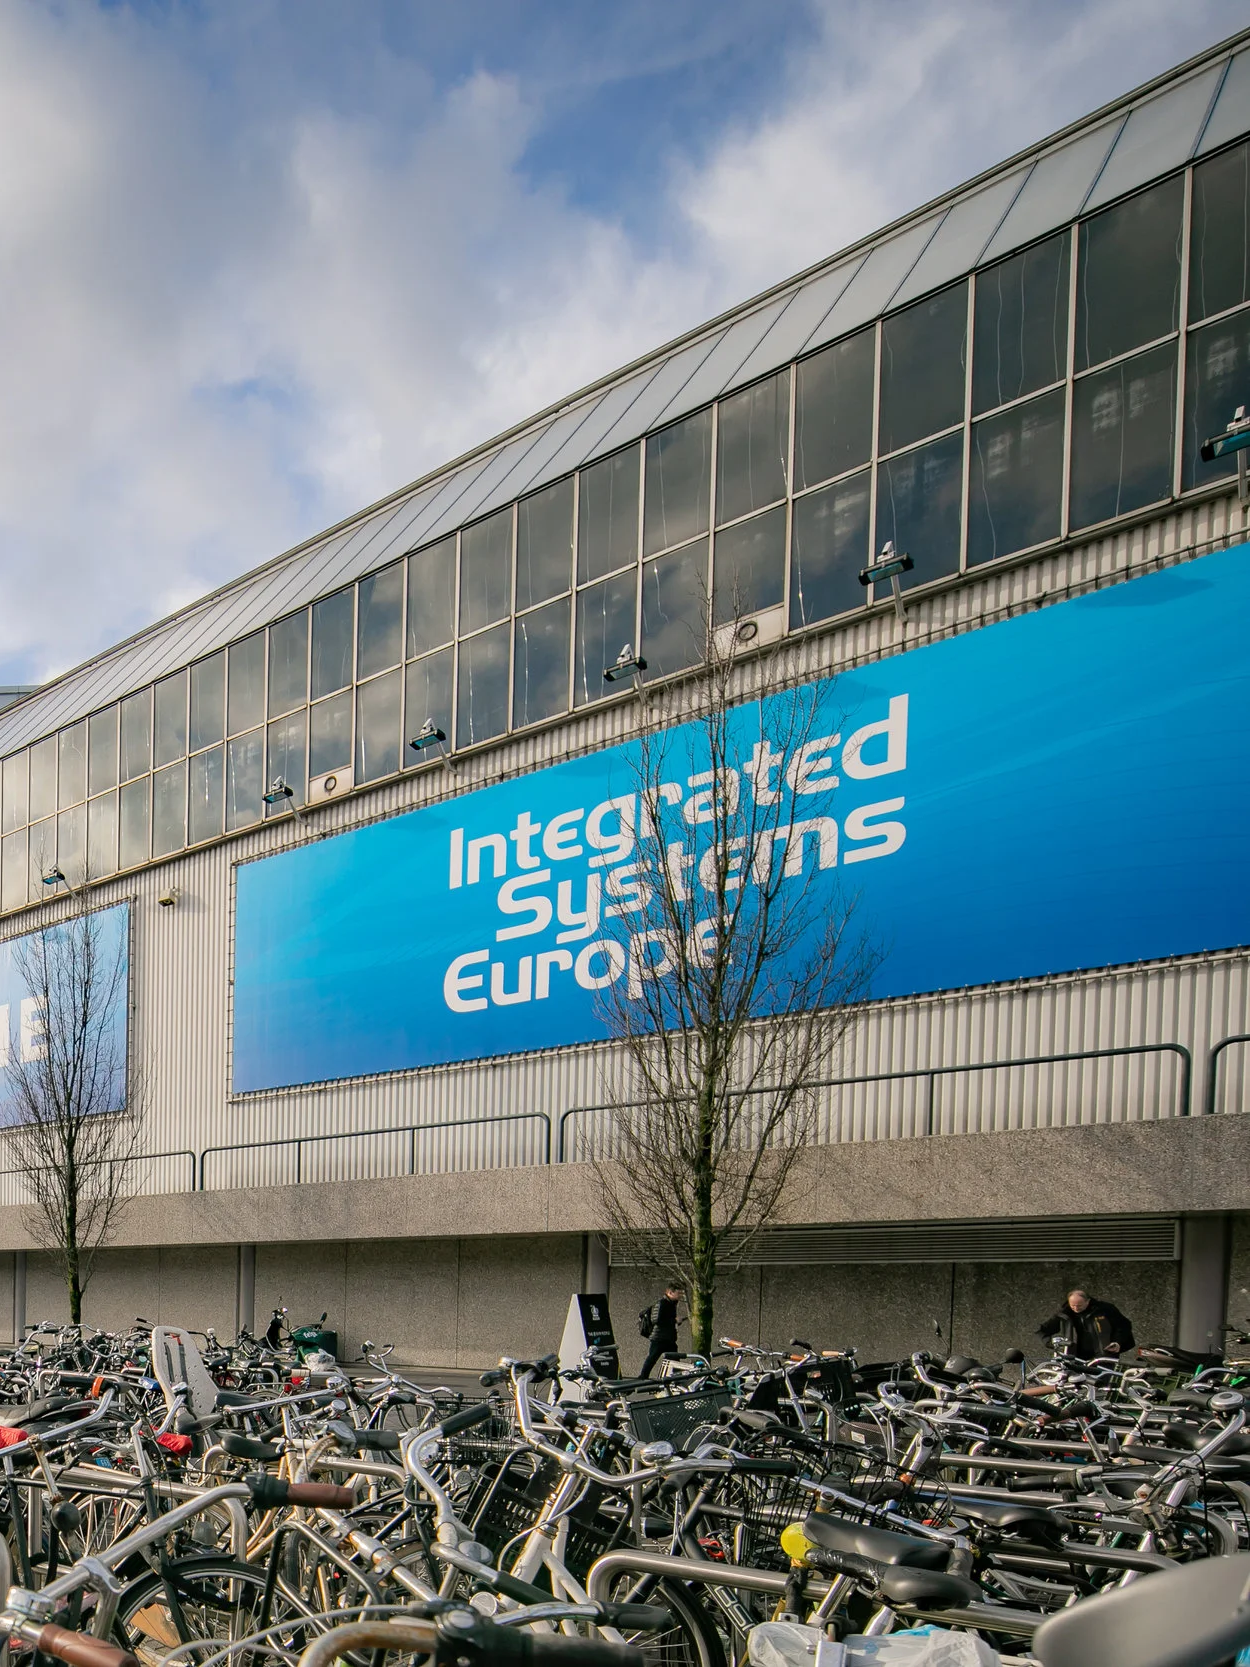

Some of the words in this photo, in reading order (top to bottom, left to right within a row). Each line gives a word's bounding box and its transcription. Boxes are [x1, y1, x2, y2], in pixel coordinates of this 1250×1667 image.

[449, 693, 909, 890] Integrated
[496, 796, 907, 943] Systems
[443, 913, 734, 1012] Europe
